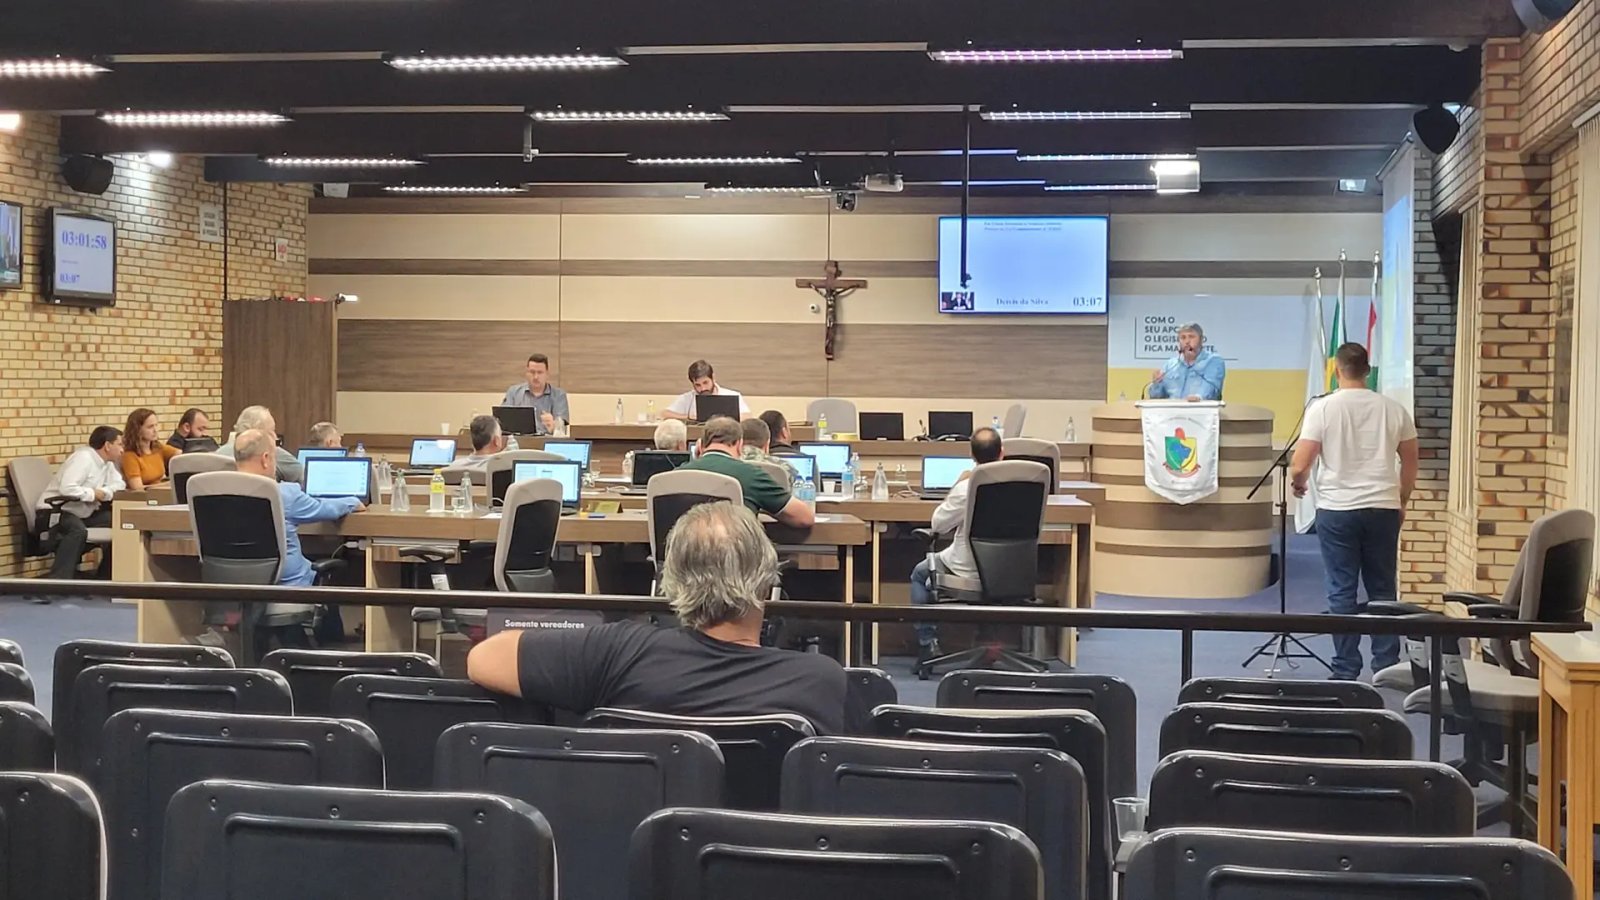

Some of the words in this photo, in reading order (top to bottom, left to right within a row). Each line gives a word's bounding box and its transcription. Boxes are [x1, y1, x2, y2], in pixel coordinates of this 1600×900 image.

[62, 231, 107, 250] 03:01:58
[1073, 297, 1102, 307] 03:07
[1144, 316, 1166, 324] COM
[1167, 316, 1175, 324] O
[1144, 326, 1160, 334] SEU
[1144, 335, 1152, 343] O
[504, 619, 539, 628] Somente
[540, 620, 585, 629] vereadores
